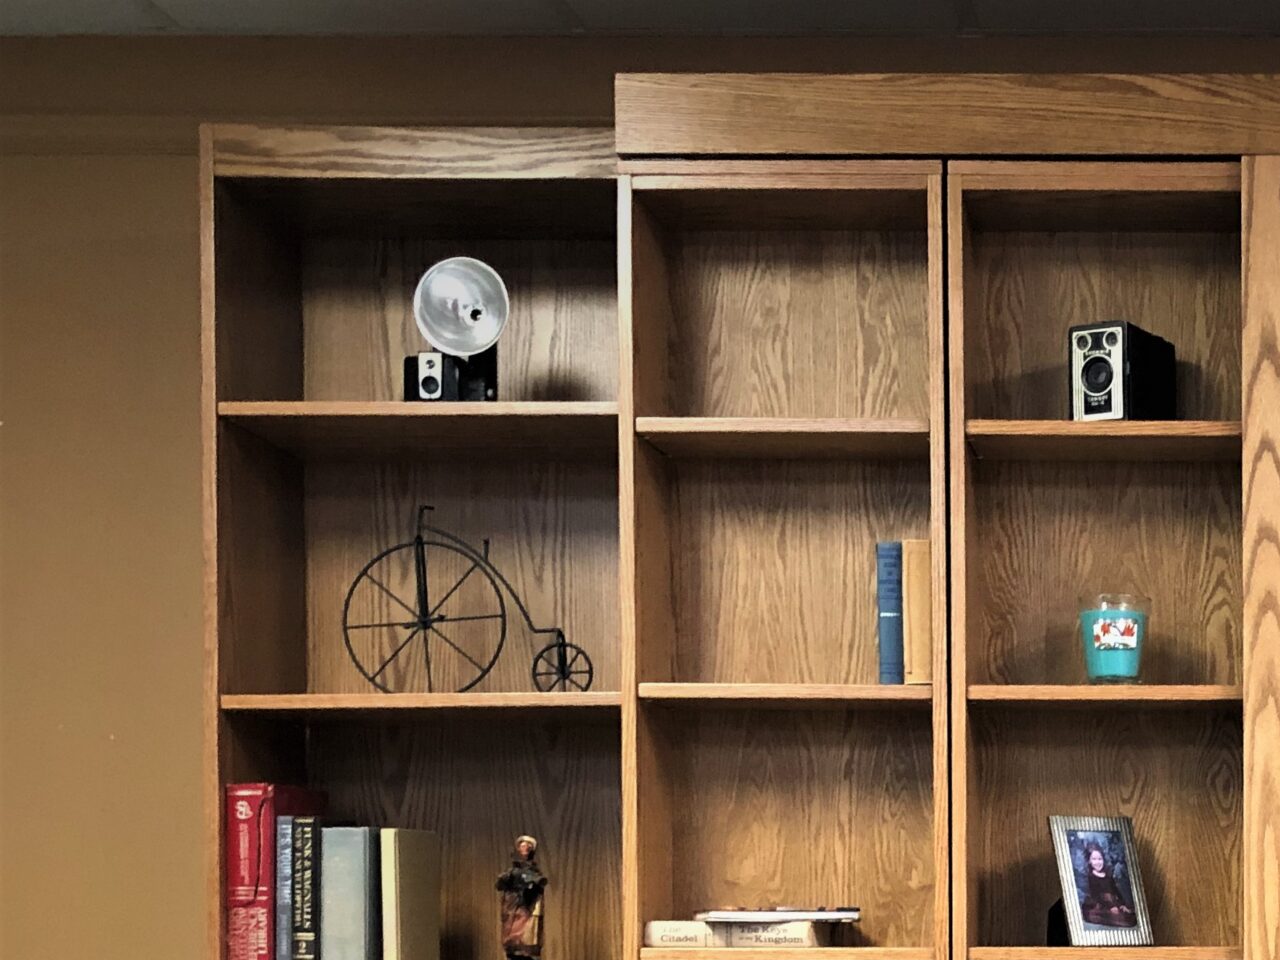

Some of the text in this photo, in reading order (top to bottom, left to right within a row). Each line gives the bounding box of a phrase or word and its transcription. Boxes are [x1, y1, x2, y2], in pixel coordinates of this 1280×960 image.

[280, 824, 292, 844] IT'S
[280, 847, 292, 876] YOUR
[280, 880, 292, 905] TIME
[660, 933, 698, 943] Citadel
[754, 935, 804, 945] Kingdom
